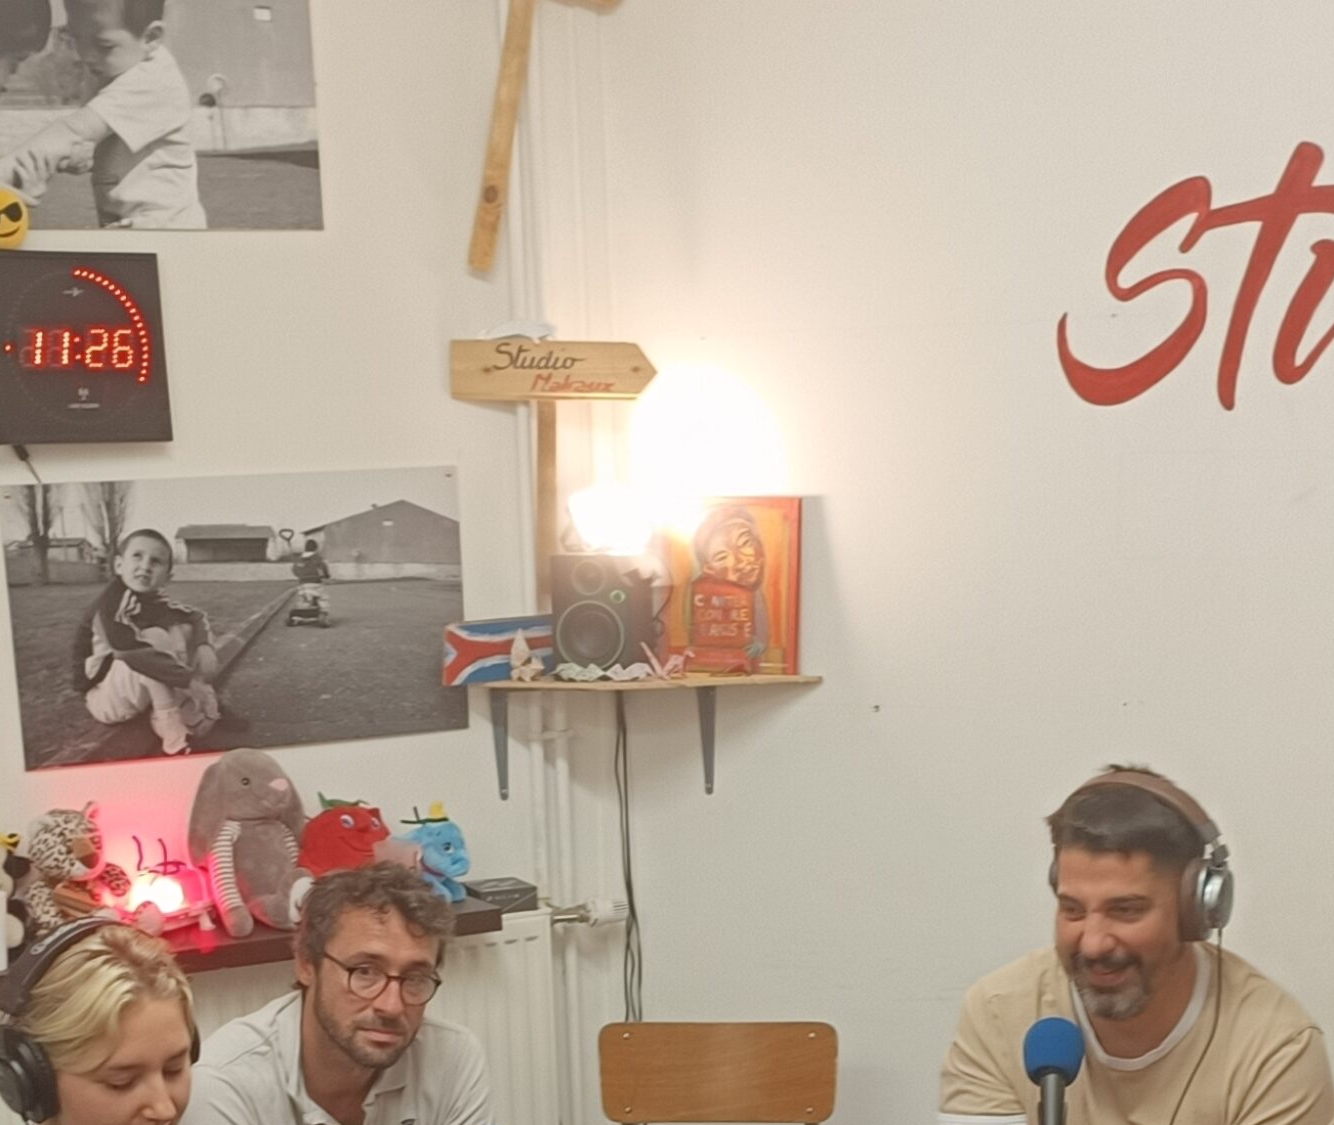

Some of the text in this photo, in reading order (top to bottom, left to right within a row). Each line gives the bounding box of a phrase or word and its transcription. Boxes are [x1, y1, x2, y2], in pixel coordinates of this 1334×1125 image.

[34, 329, 134, 368] 11:26
[492, 342, 585, 371] Studio
[530, 373, 616, 393] Malraux
